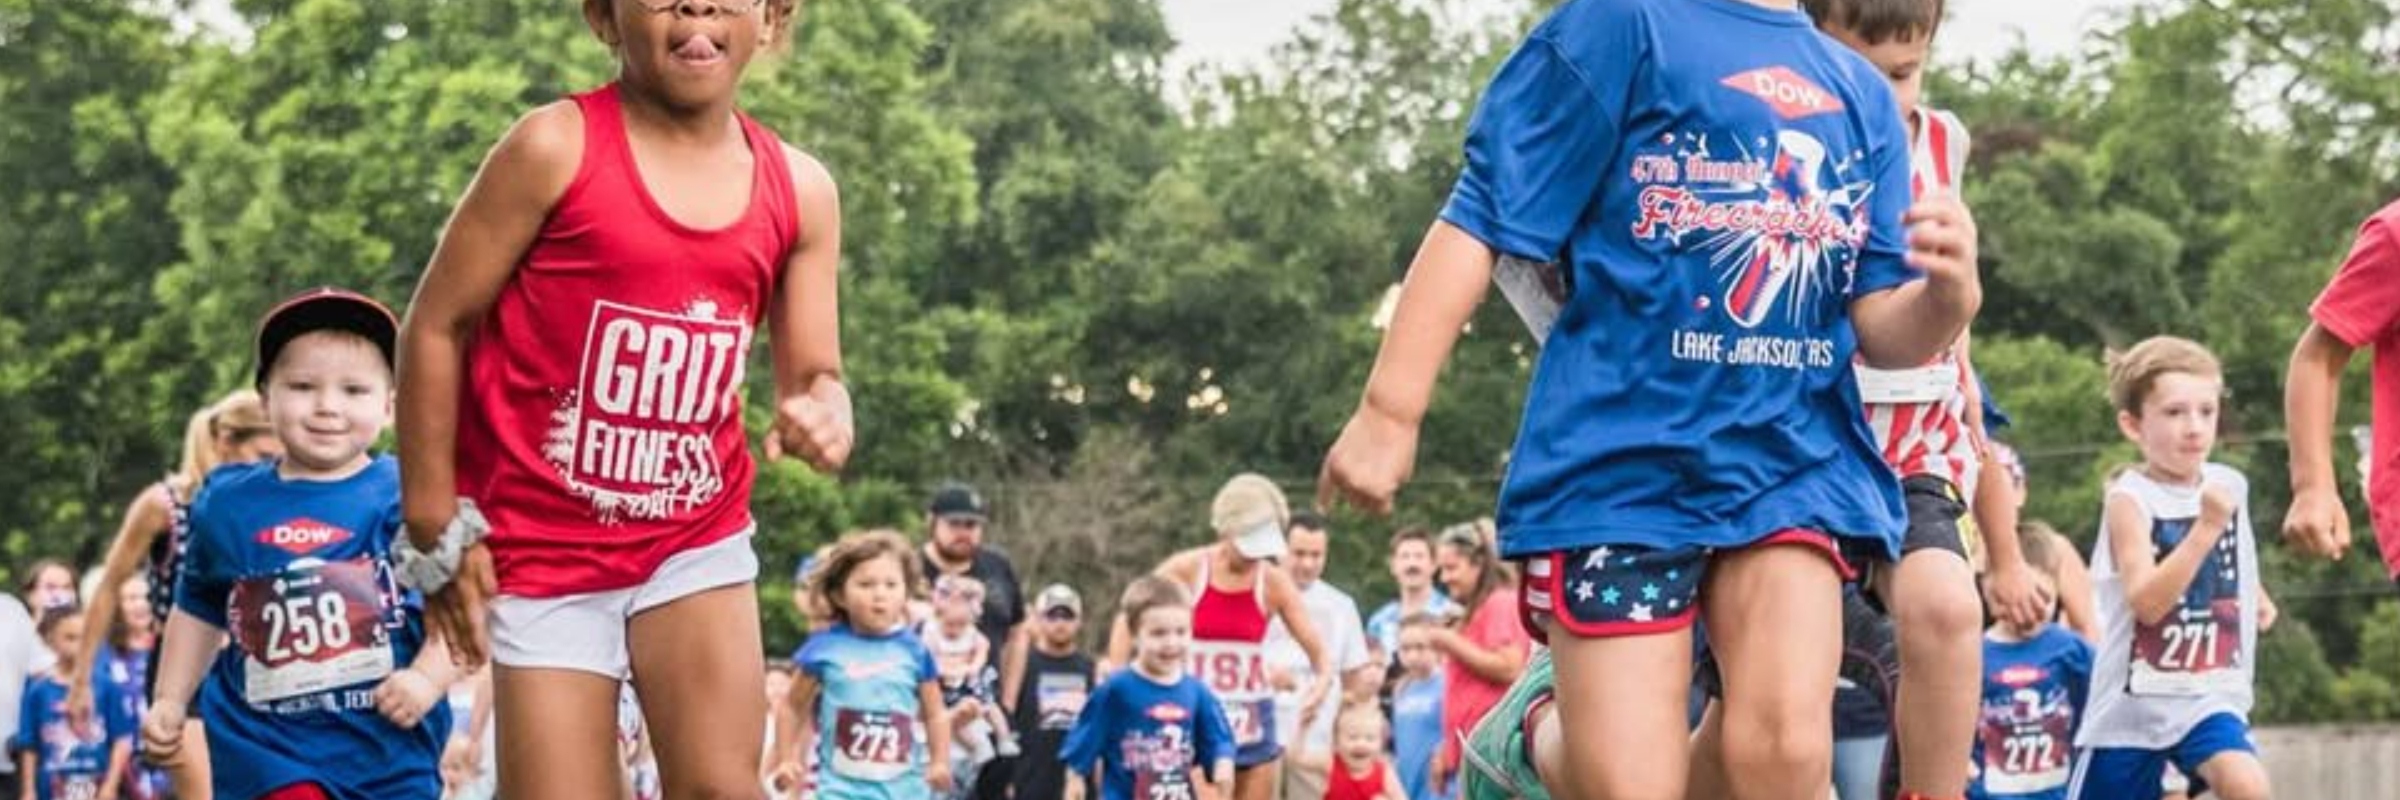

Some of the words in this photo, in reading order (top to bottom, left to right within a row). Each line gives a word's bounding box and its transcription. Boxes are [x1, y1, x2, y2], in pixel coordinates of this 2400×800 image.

[1671, 329, 1724, 363] LAKE
[593, 317, 736, 424] GRIT
[581, 418, 711, 490] FITNESS
[261, 591, 350, 661] 258
[2159, 621, 2218, 669] 271
[849, 722, 899, 761] 273
[2003, 733, 2054, 772] 272
